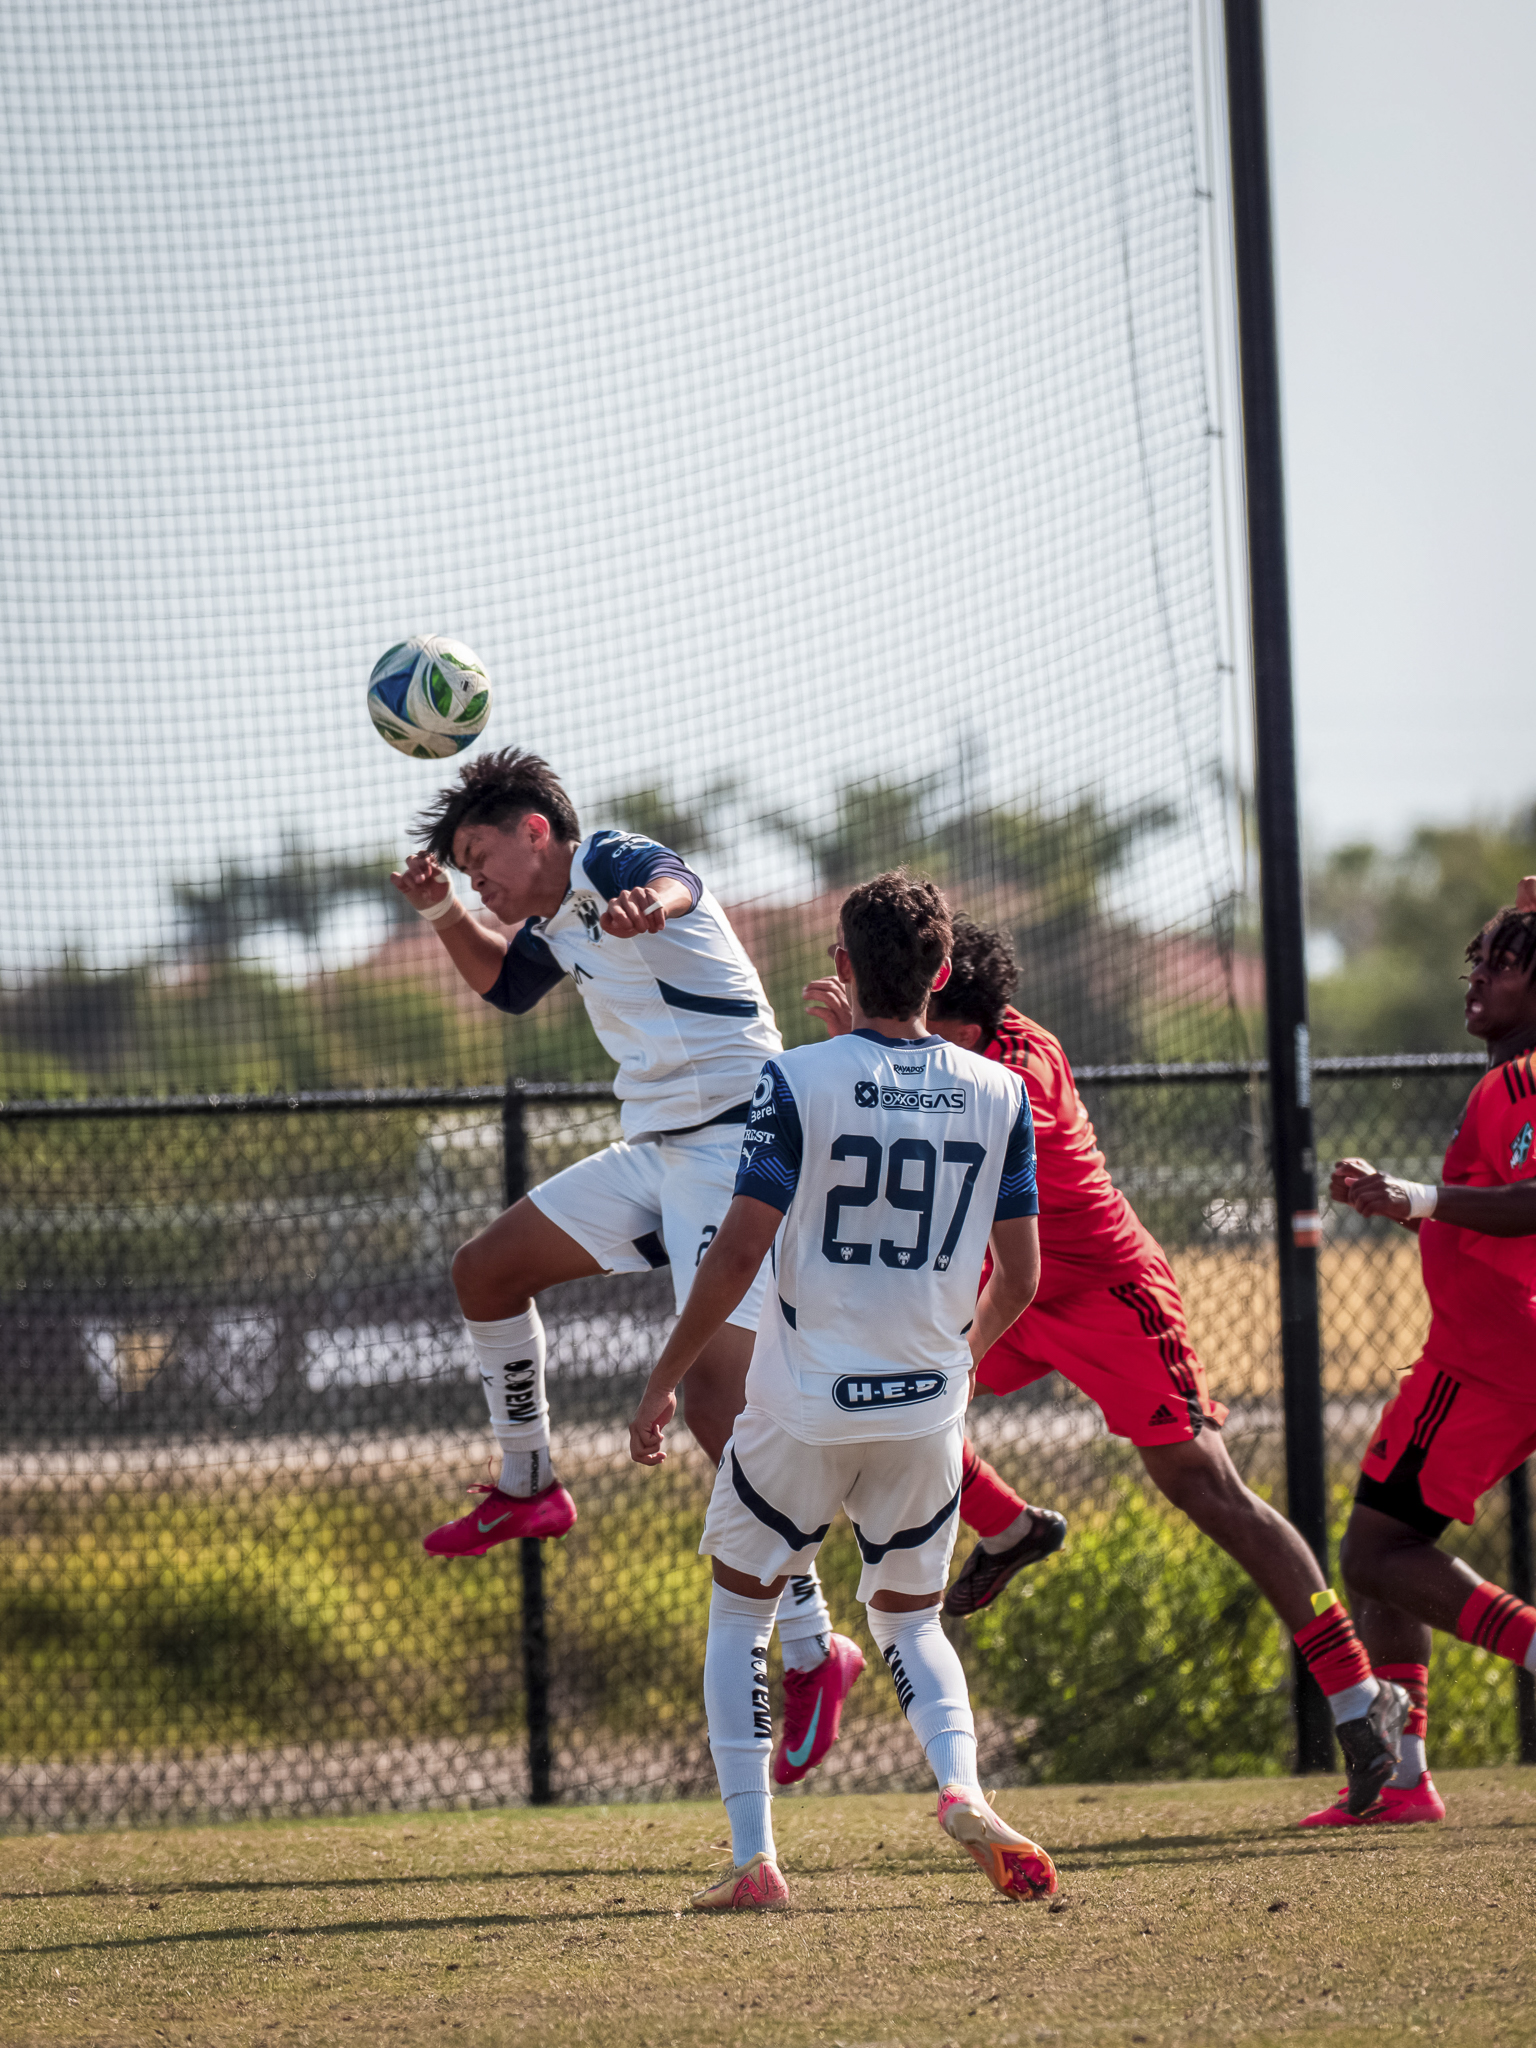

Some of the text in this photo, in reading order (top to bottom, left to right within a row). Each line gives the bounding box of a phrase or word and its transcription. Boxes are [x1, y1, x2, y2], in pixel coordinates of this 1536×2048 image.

[893, 1064, 926, 1075] RAYADOS
[751, 1102, 776, 1124] Berel
[743, 1128, 776, 1145] REST
[822, 1134, 987, 1272] 297
